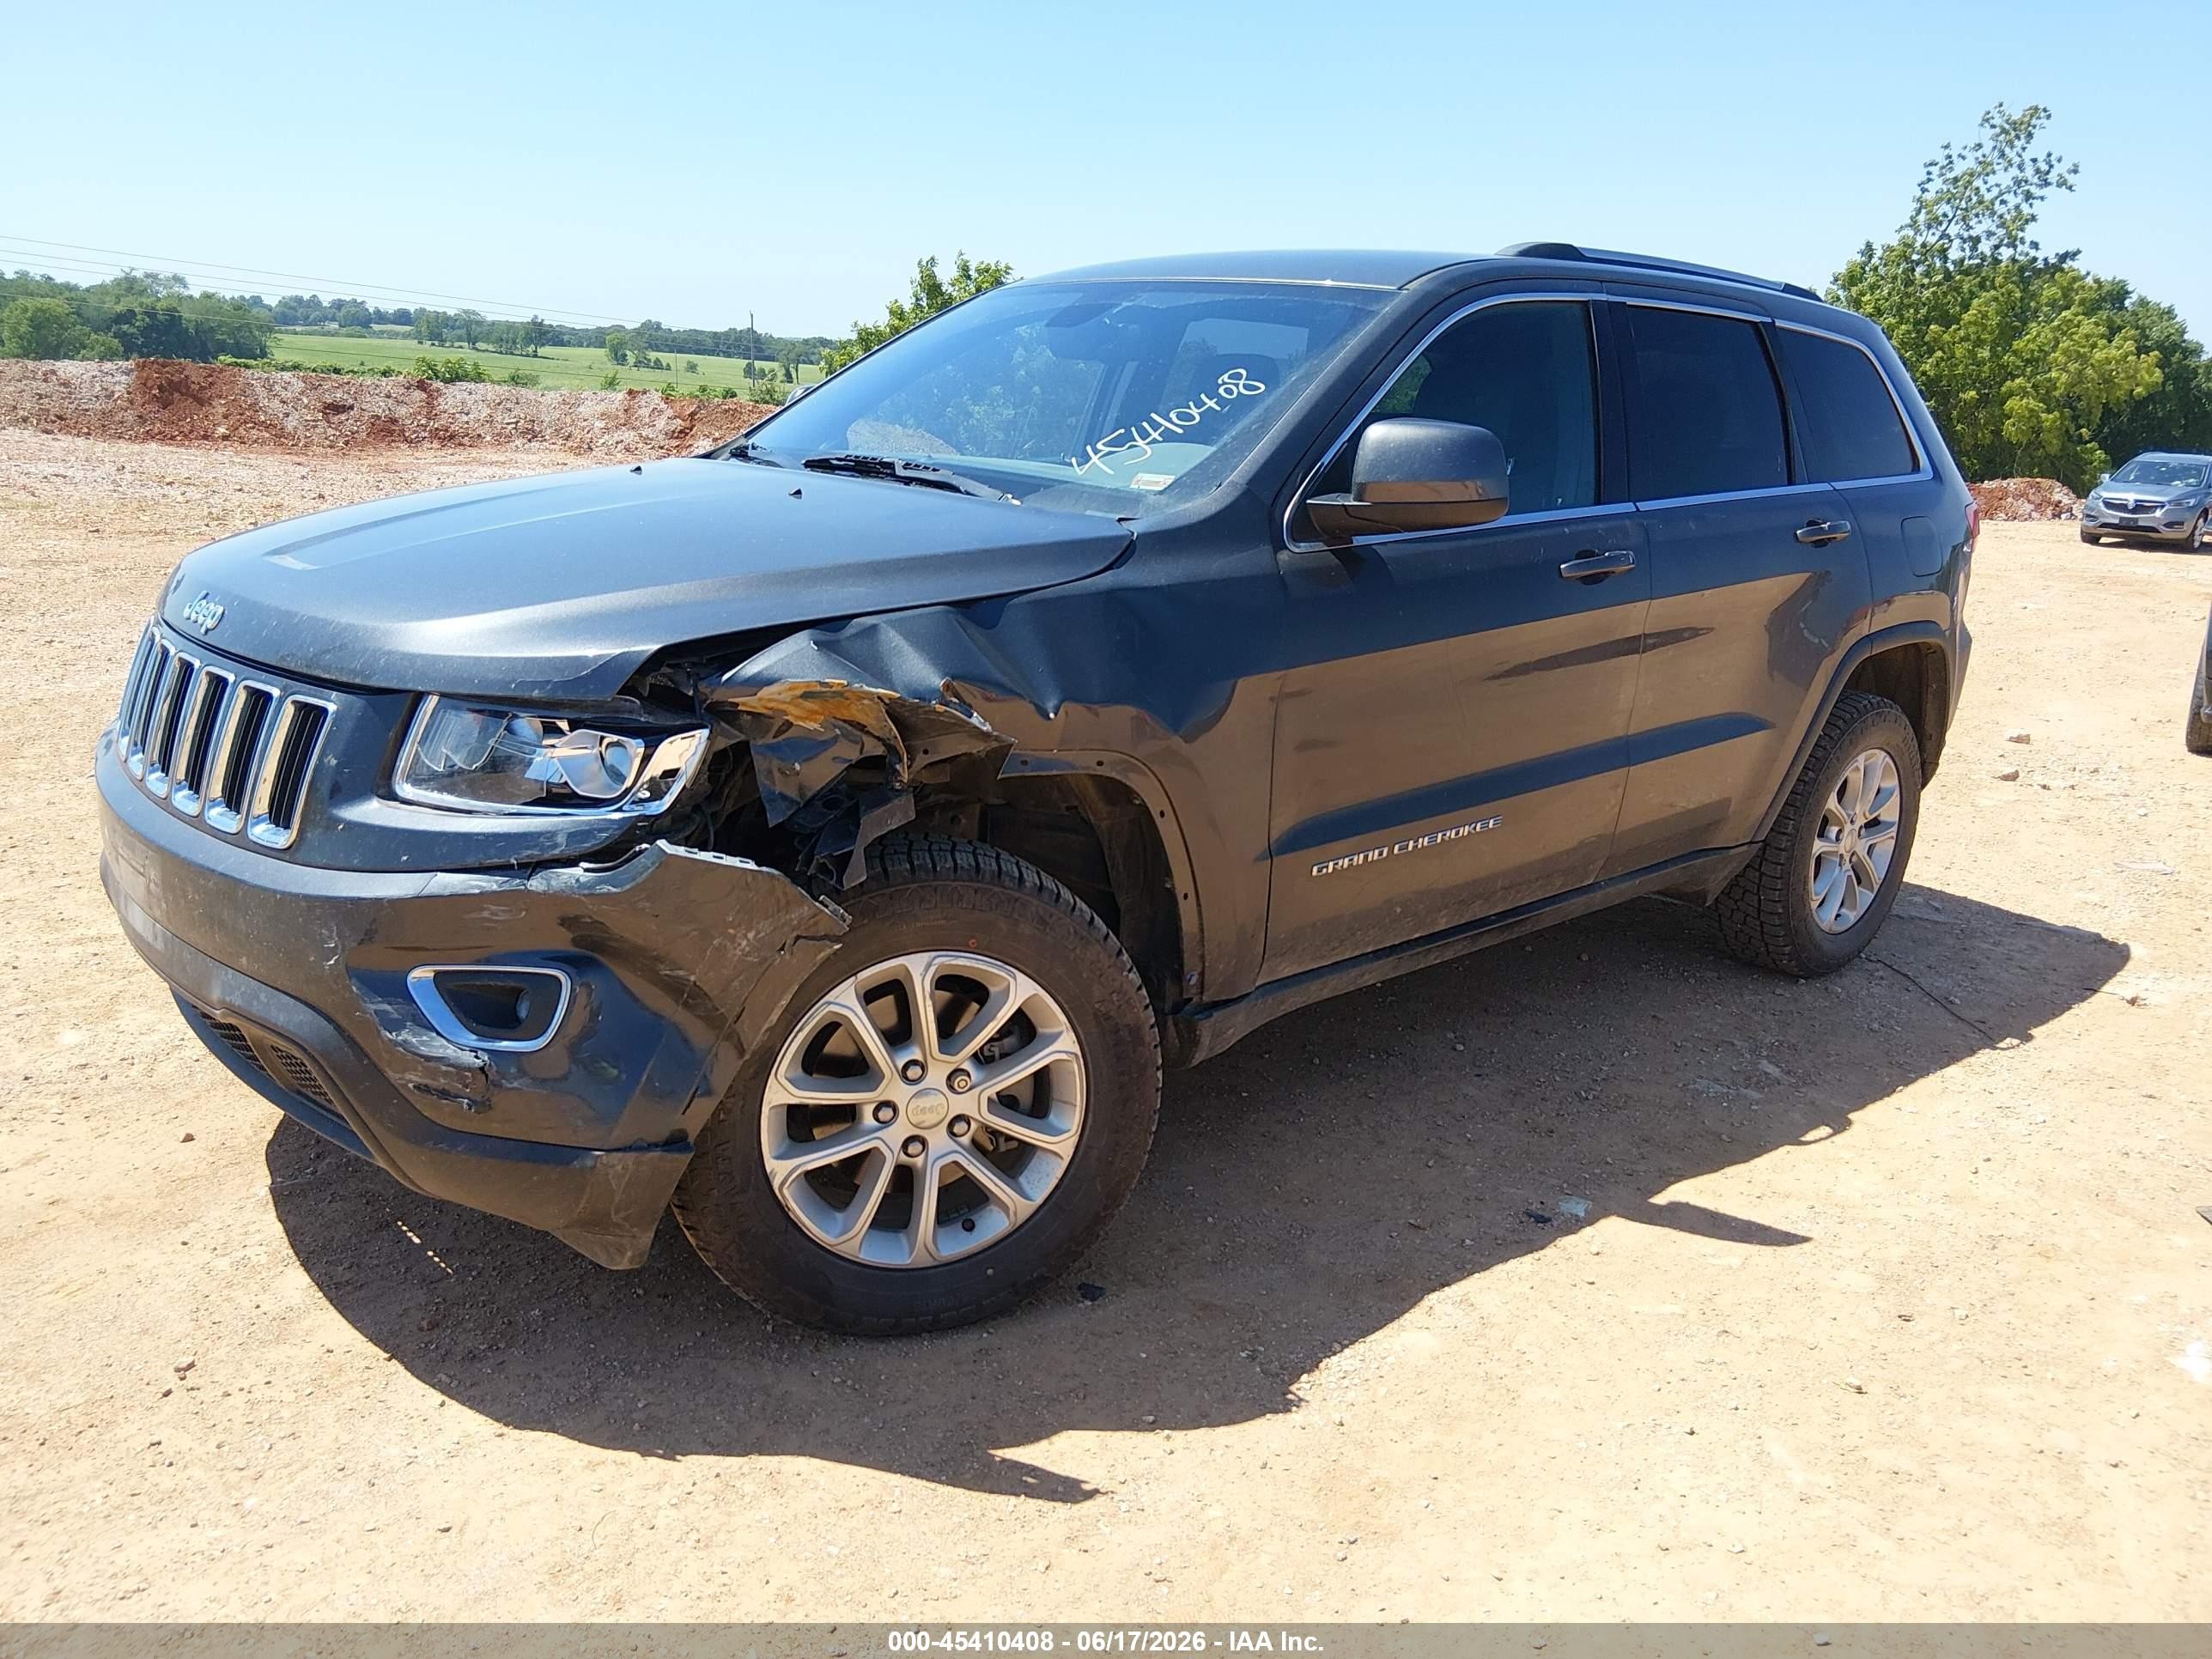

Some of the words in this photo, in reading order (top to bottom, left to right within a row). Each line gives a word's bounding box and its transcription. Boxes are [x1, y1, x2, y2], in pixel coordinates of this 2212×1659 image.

[1072, 368, 1266, 475] 45410408
[183, 591, 225, 635] Jeep
[1311, 845, 1389, 878] GRAND
[1393, 815, 1503, 855] CHEROKEE
